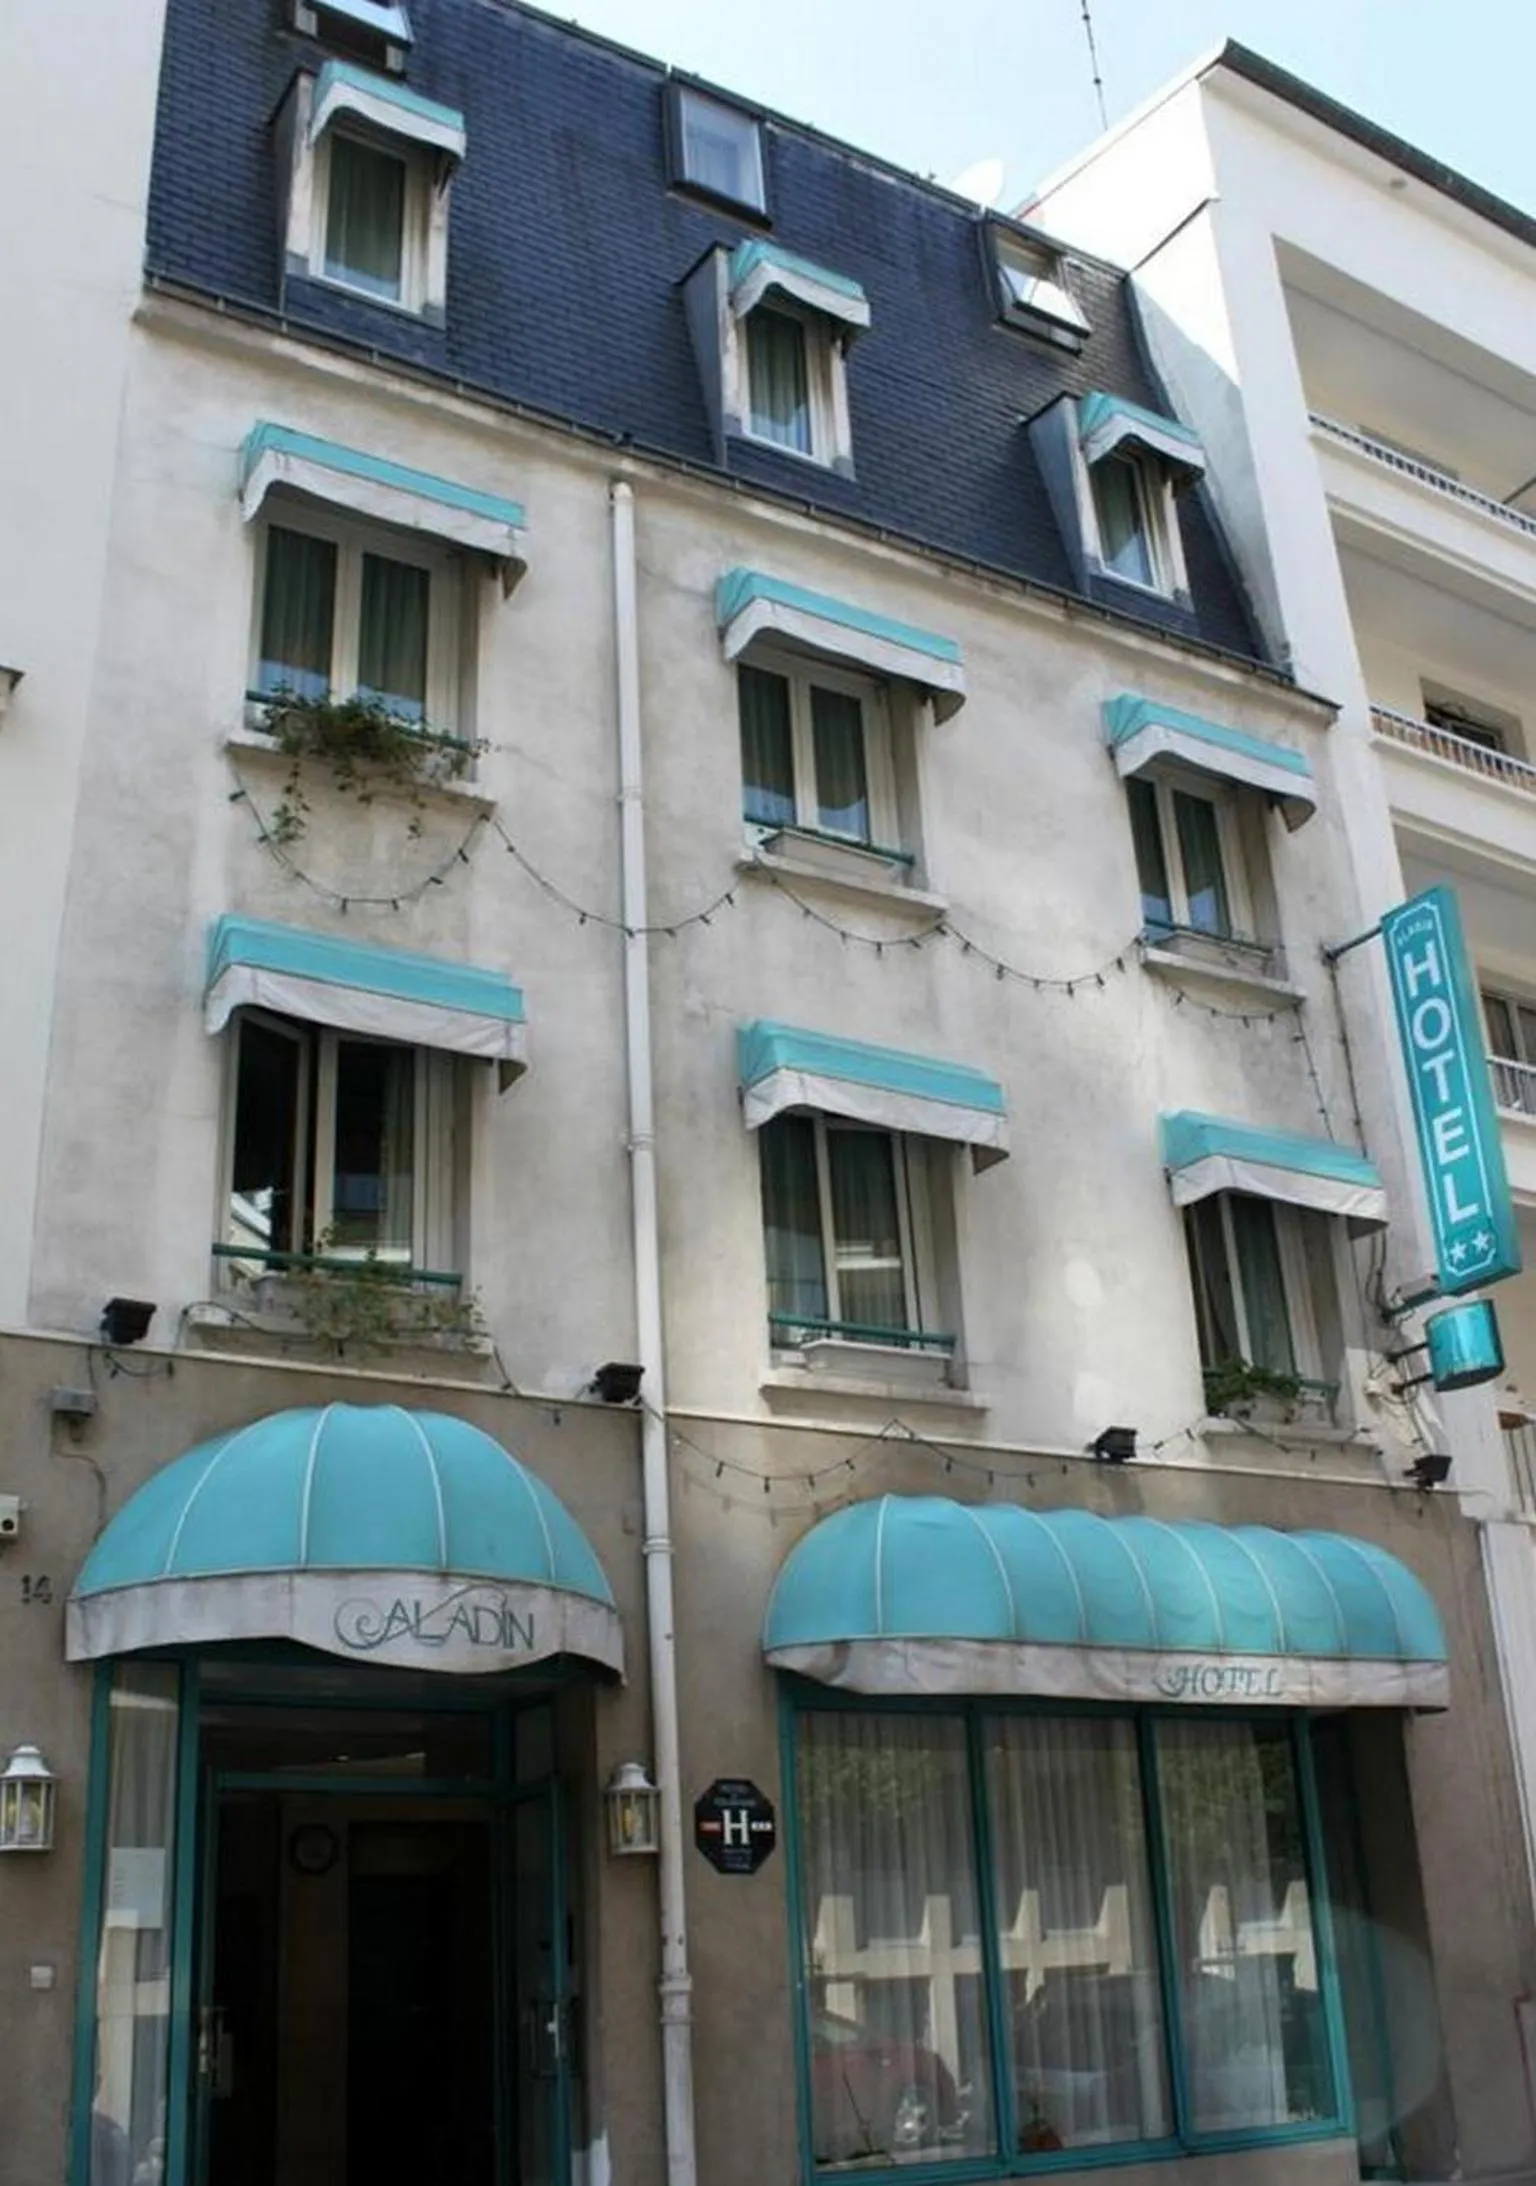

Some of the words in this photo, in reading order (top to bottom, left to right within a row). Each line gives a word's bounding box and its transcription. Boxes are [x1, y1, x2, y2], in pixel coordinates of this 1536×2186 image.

[1402, 938, 1480, 1226] HOTEL
[21, 1574, 53, 1605] 14
[334, 1585, 534, 1651] ALADIN
[1153, 1664, 1283, 1699] HOTEL
[722, 1809, 750, 1845] H
